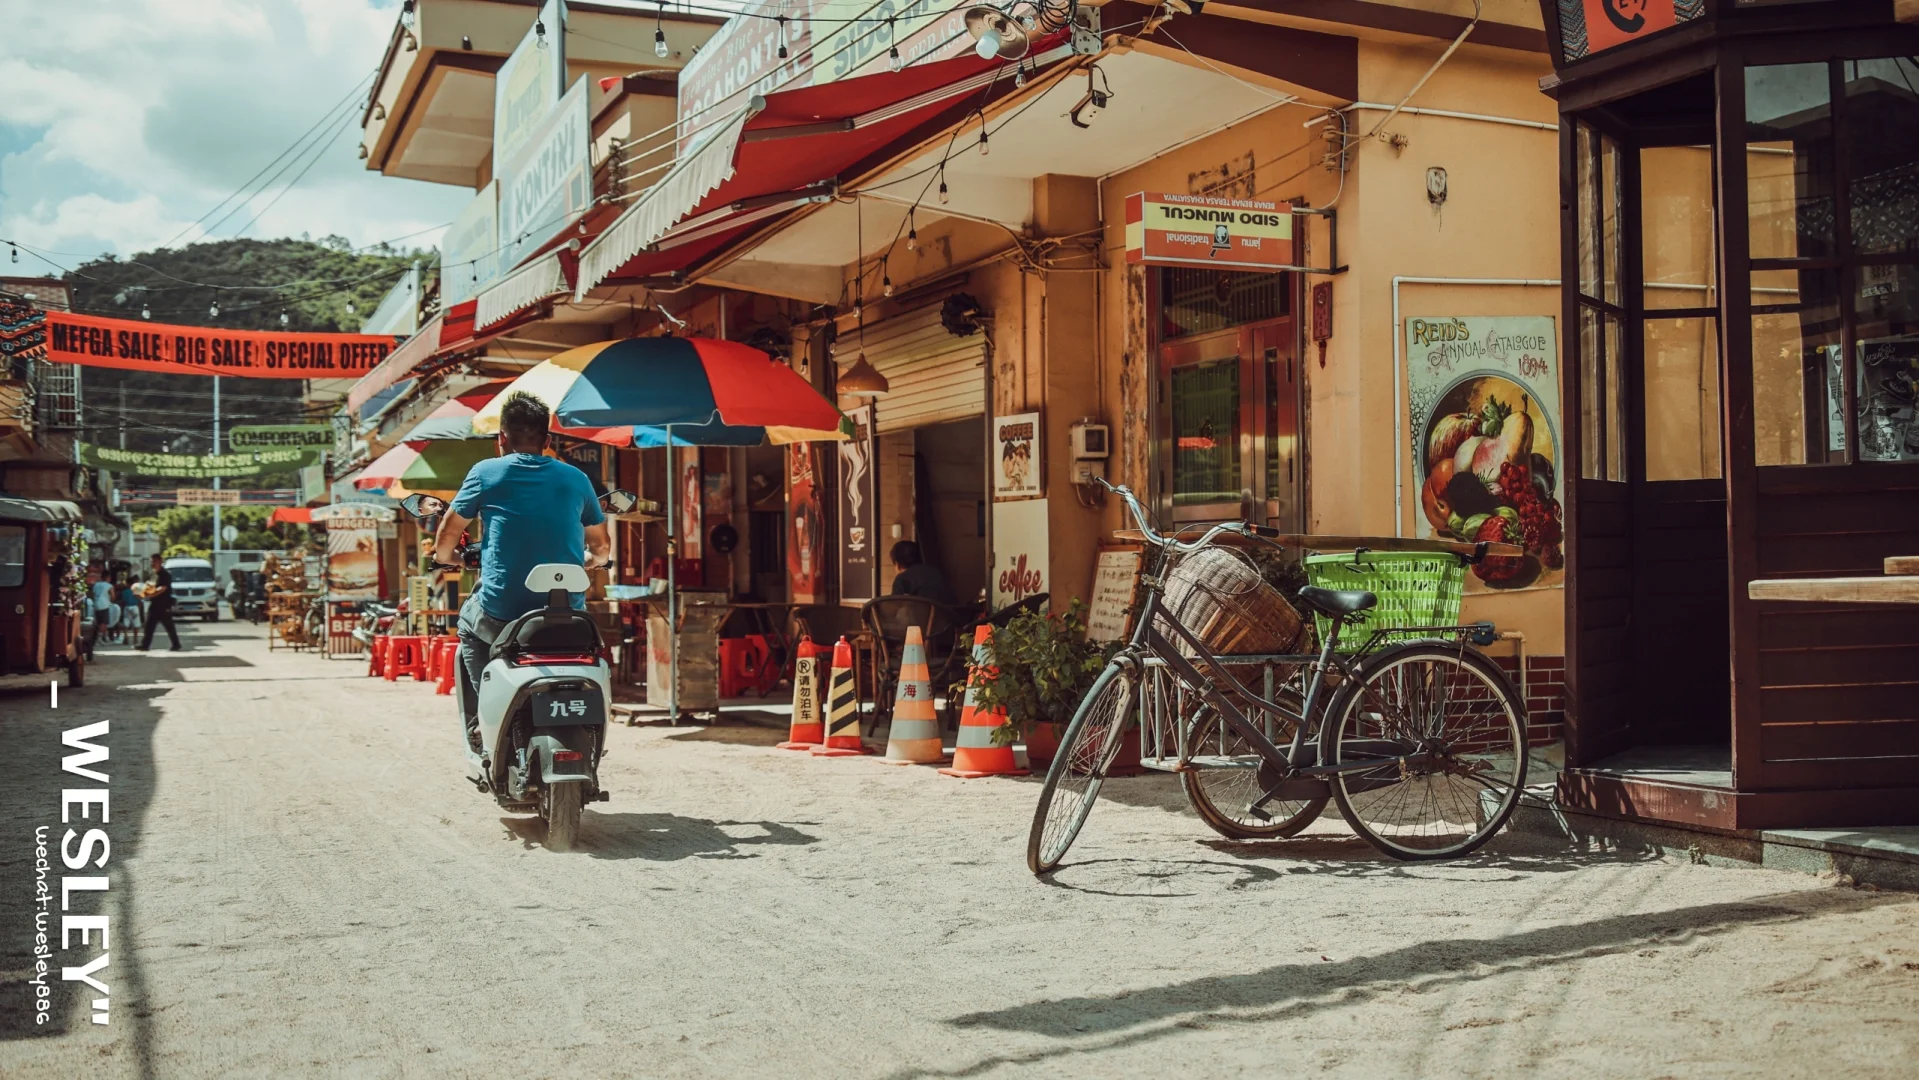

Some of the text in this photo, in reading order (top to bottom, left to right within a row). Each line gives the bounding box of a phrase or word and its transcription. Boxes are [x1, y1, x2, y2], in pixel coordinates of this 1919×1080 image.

[833, 0, 896, 75] SIDO
[682, 10, 803, 133] POCAHONTAS
[514, 113, 577, 231] KONTIKI
[1163, 193, 1275, 210] BENAR BENAR TERASA KHASIATNYA
[1160, 206, 1279, 226] SIDO MUNCUL
[1166, 232, 1261, 250] jamu tradisional
[52, 323, 113, 357] MEFGA
[175, 336, 206, 364] BIG
[266, 340, 336, 369] SPECIAL
[1412, 318, 1470, 348] REID'S
[1428, 328, 1547, 367] ANNUAL CATALOGUE
[1518, 354, 1549, 377] 1894
[232, 431, 334, 447] COMFORTABLE
[999, 422, 1034, 443] COFFEE
[328, 519, 378, 529] BURGERS
[999, 553, 1043, 601] coffee
[550, 700, 587, 717] 九号
[799, 675, 812, 721] 请勿泊车
